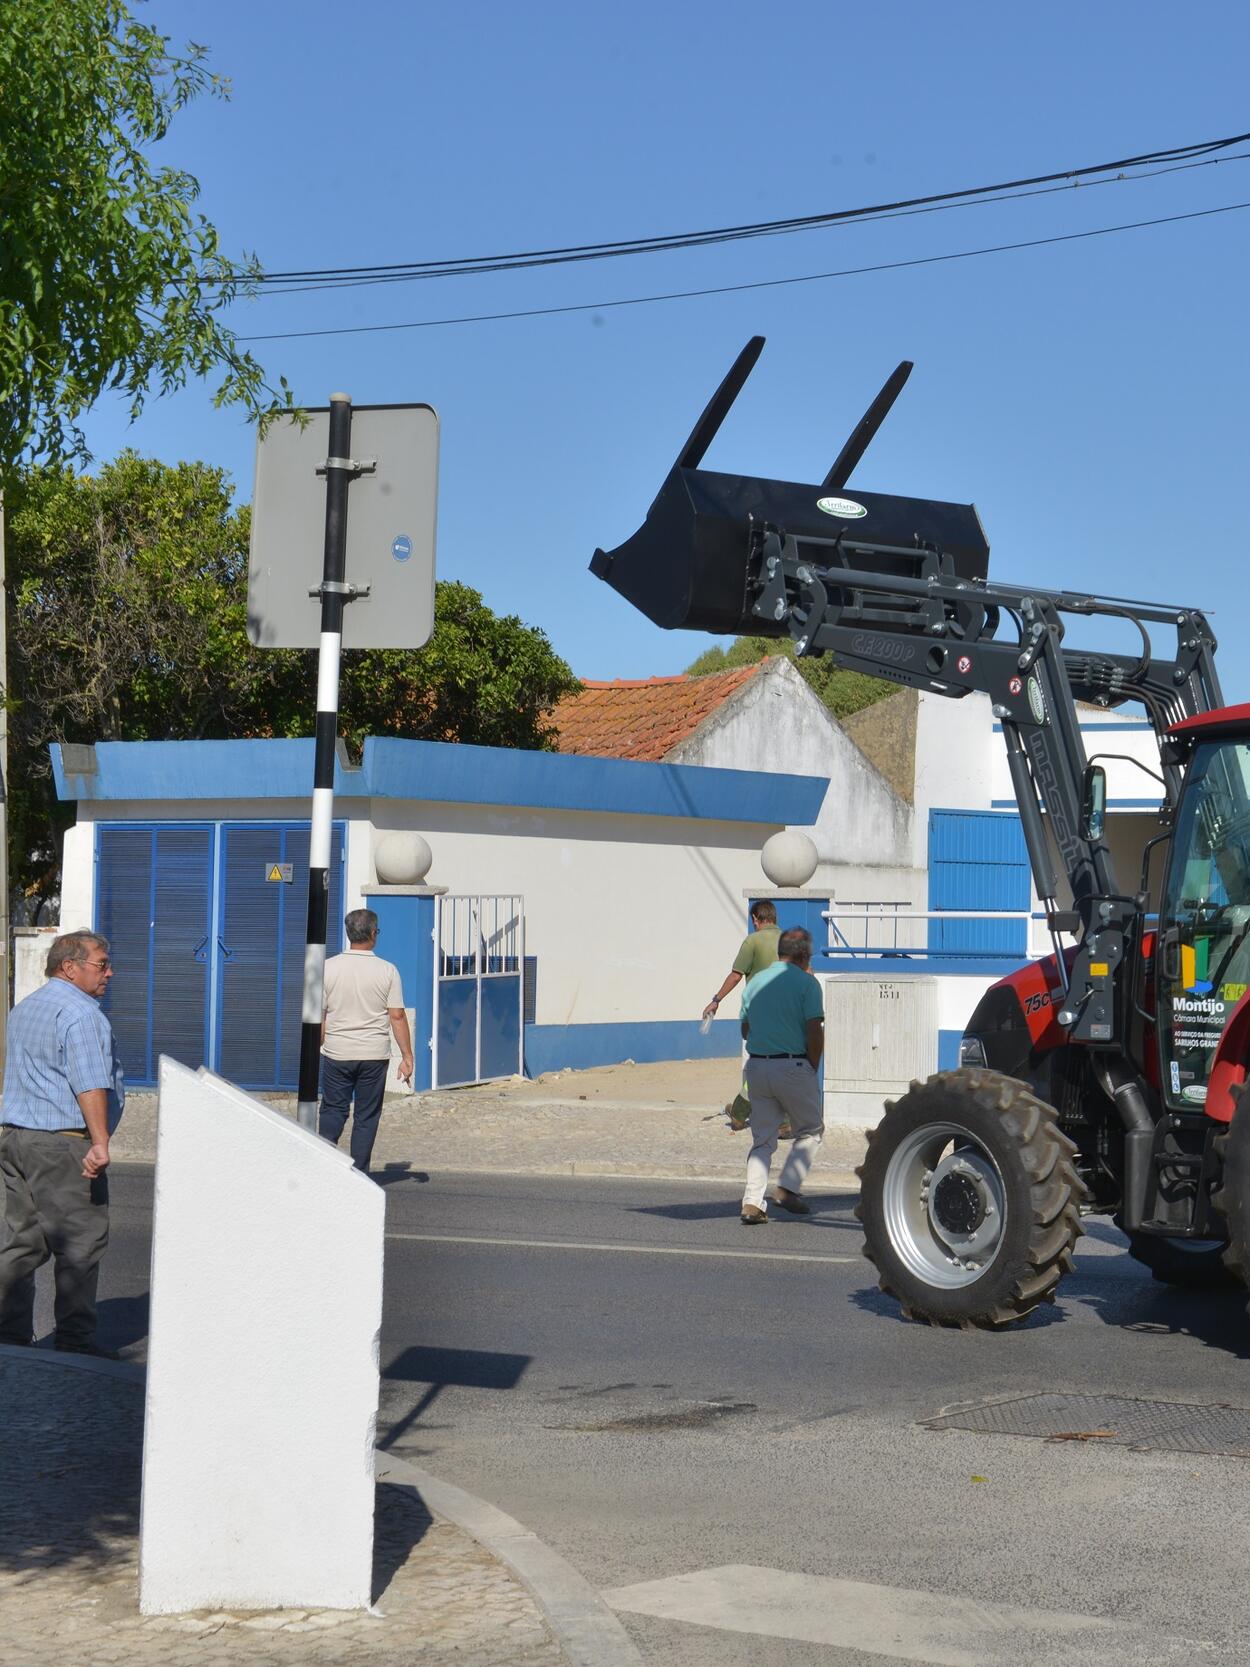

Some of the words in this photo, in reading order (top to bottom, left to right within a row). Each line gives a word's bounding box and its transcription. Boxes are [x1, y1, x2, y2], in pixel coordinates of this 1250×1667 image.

[1173, 997, 1224, 1015] Montijo
[1173, 1014, 1196, 1023] Câmara
[1196, 1015, 1226, 1024] Municipal
[1174, 1038, 1199, 1047] SARILHOS
